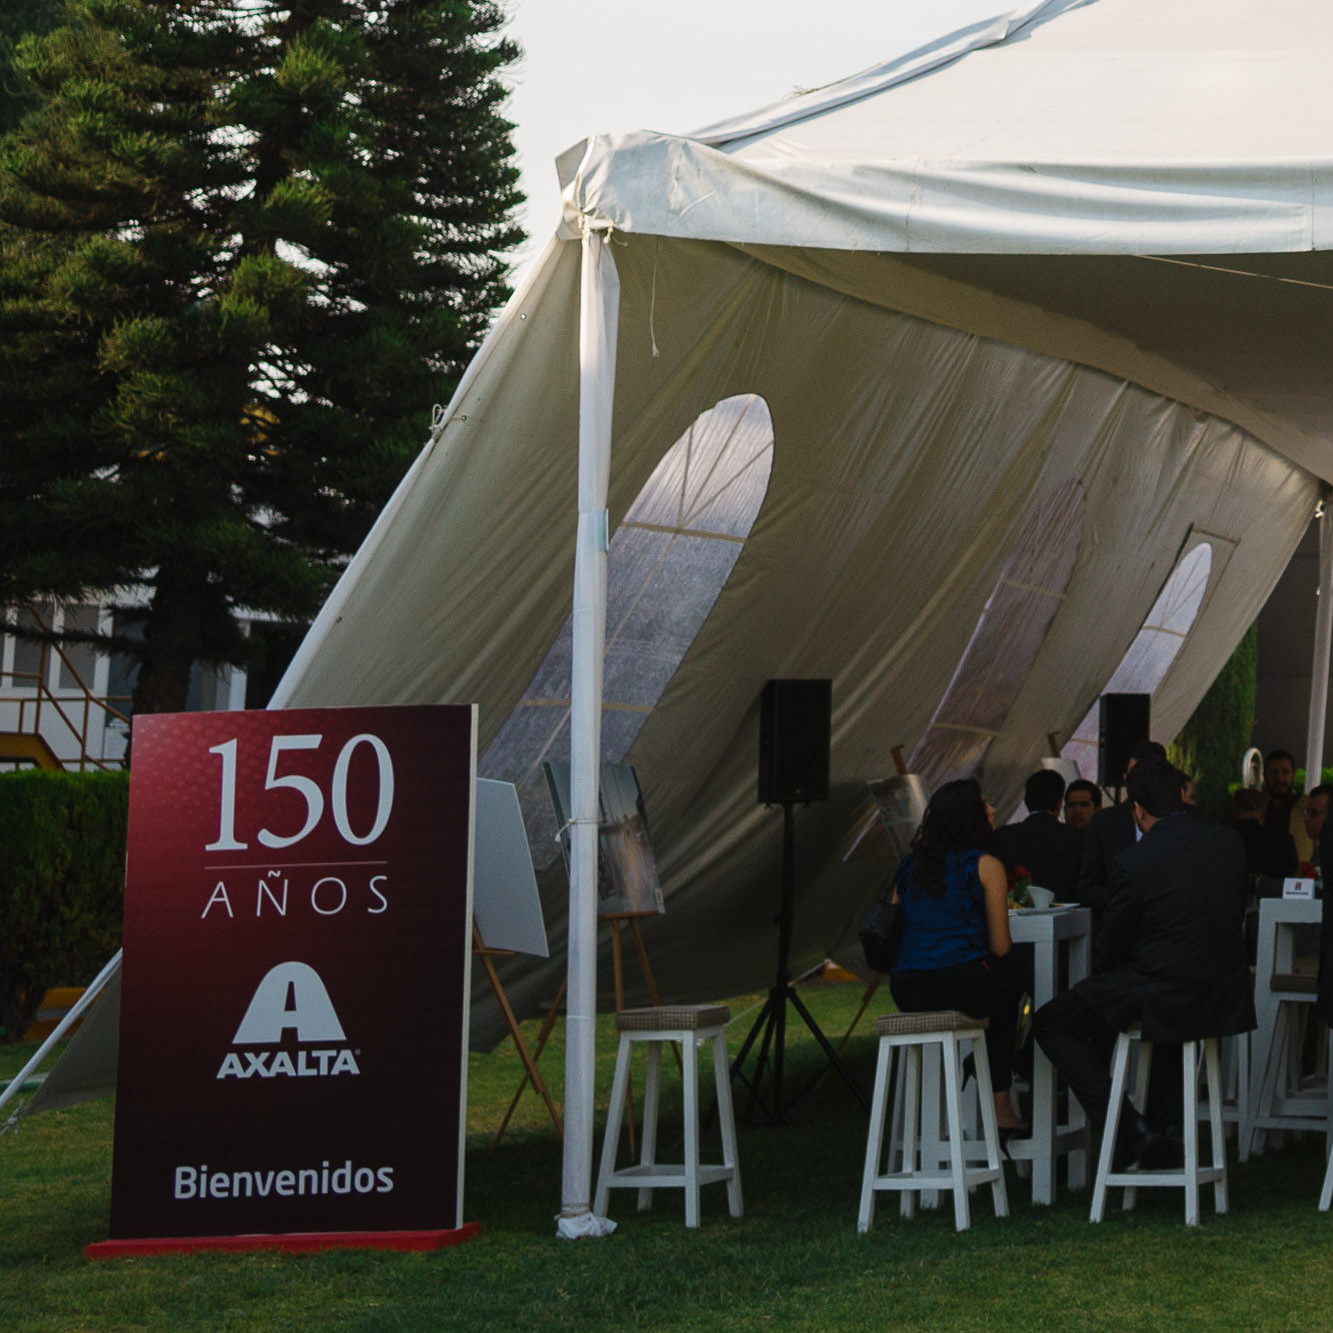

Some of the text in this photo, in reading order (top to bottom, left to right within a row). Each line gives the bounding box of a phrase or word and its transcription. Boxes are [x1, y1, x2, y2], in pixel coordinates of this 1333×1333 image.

[205, 733, 395, 851] 150
[201, 870, 387, 918] AÑOS
[216, 1049, 360, 1079] AXALTA
[174, 1160, 394, 1199] Bienvenidos
